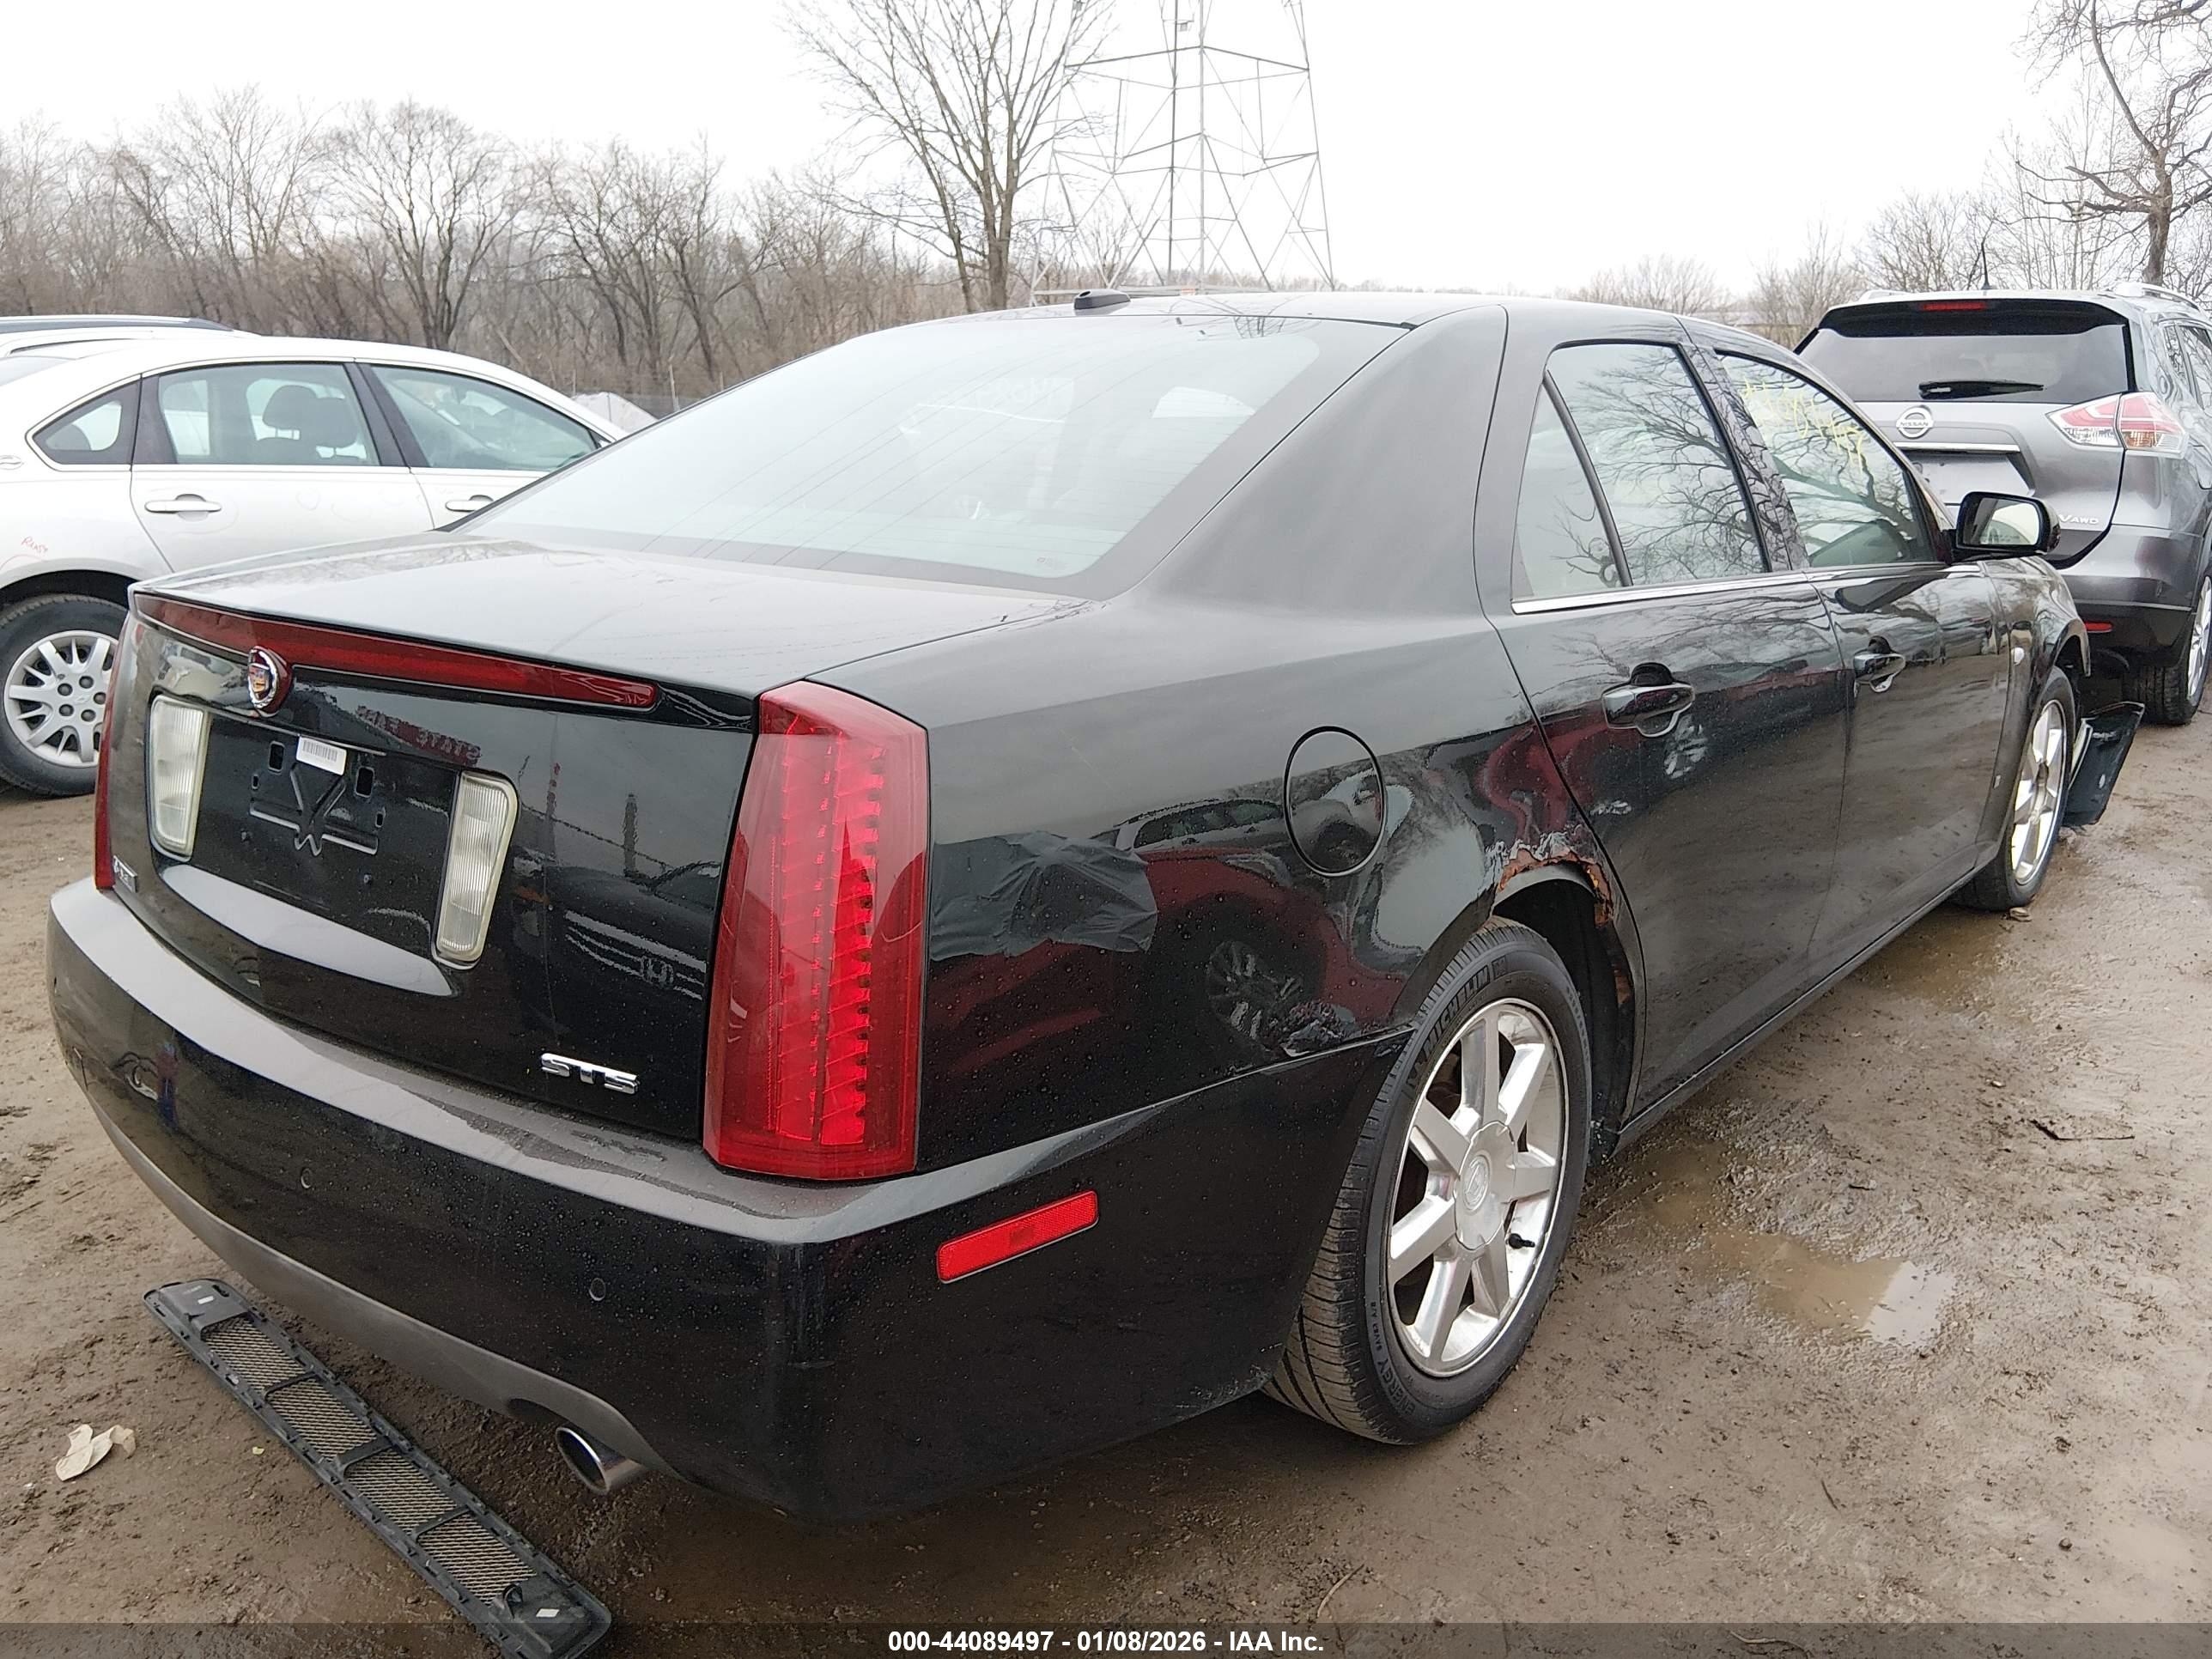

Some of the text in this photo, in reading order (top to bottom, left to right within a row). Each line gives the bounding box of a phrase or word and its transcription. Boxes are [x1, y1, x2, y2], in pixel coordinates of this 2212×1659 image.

[1421, 963, 1491, 1059] MICHELIN
[540, 1052, 639, 1095] STS
[1377, 1358, 1417, 1415] ENERGY
